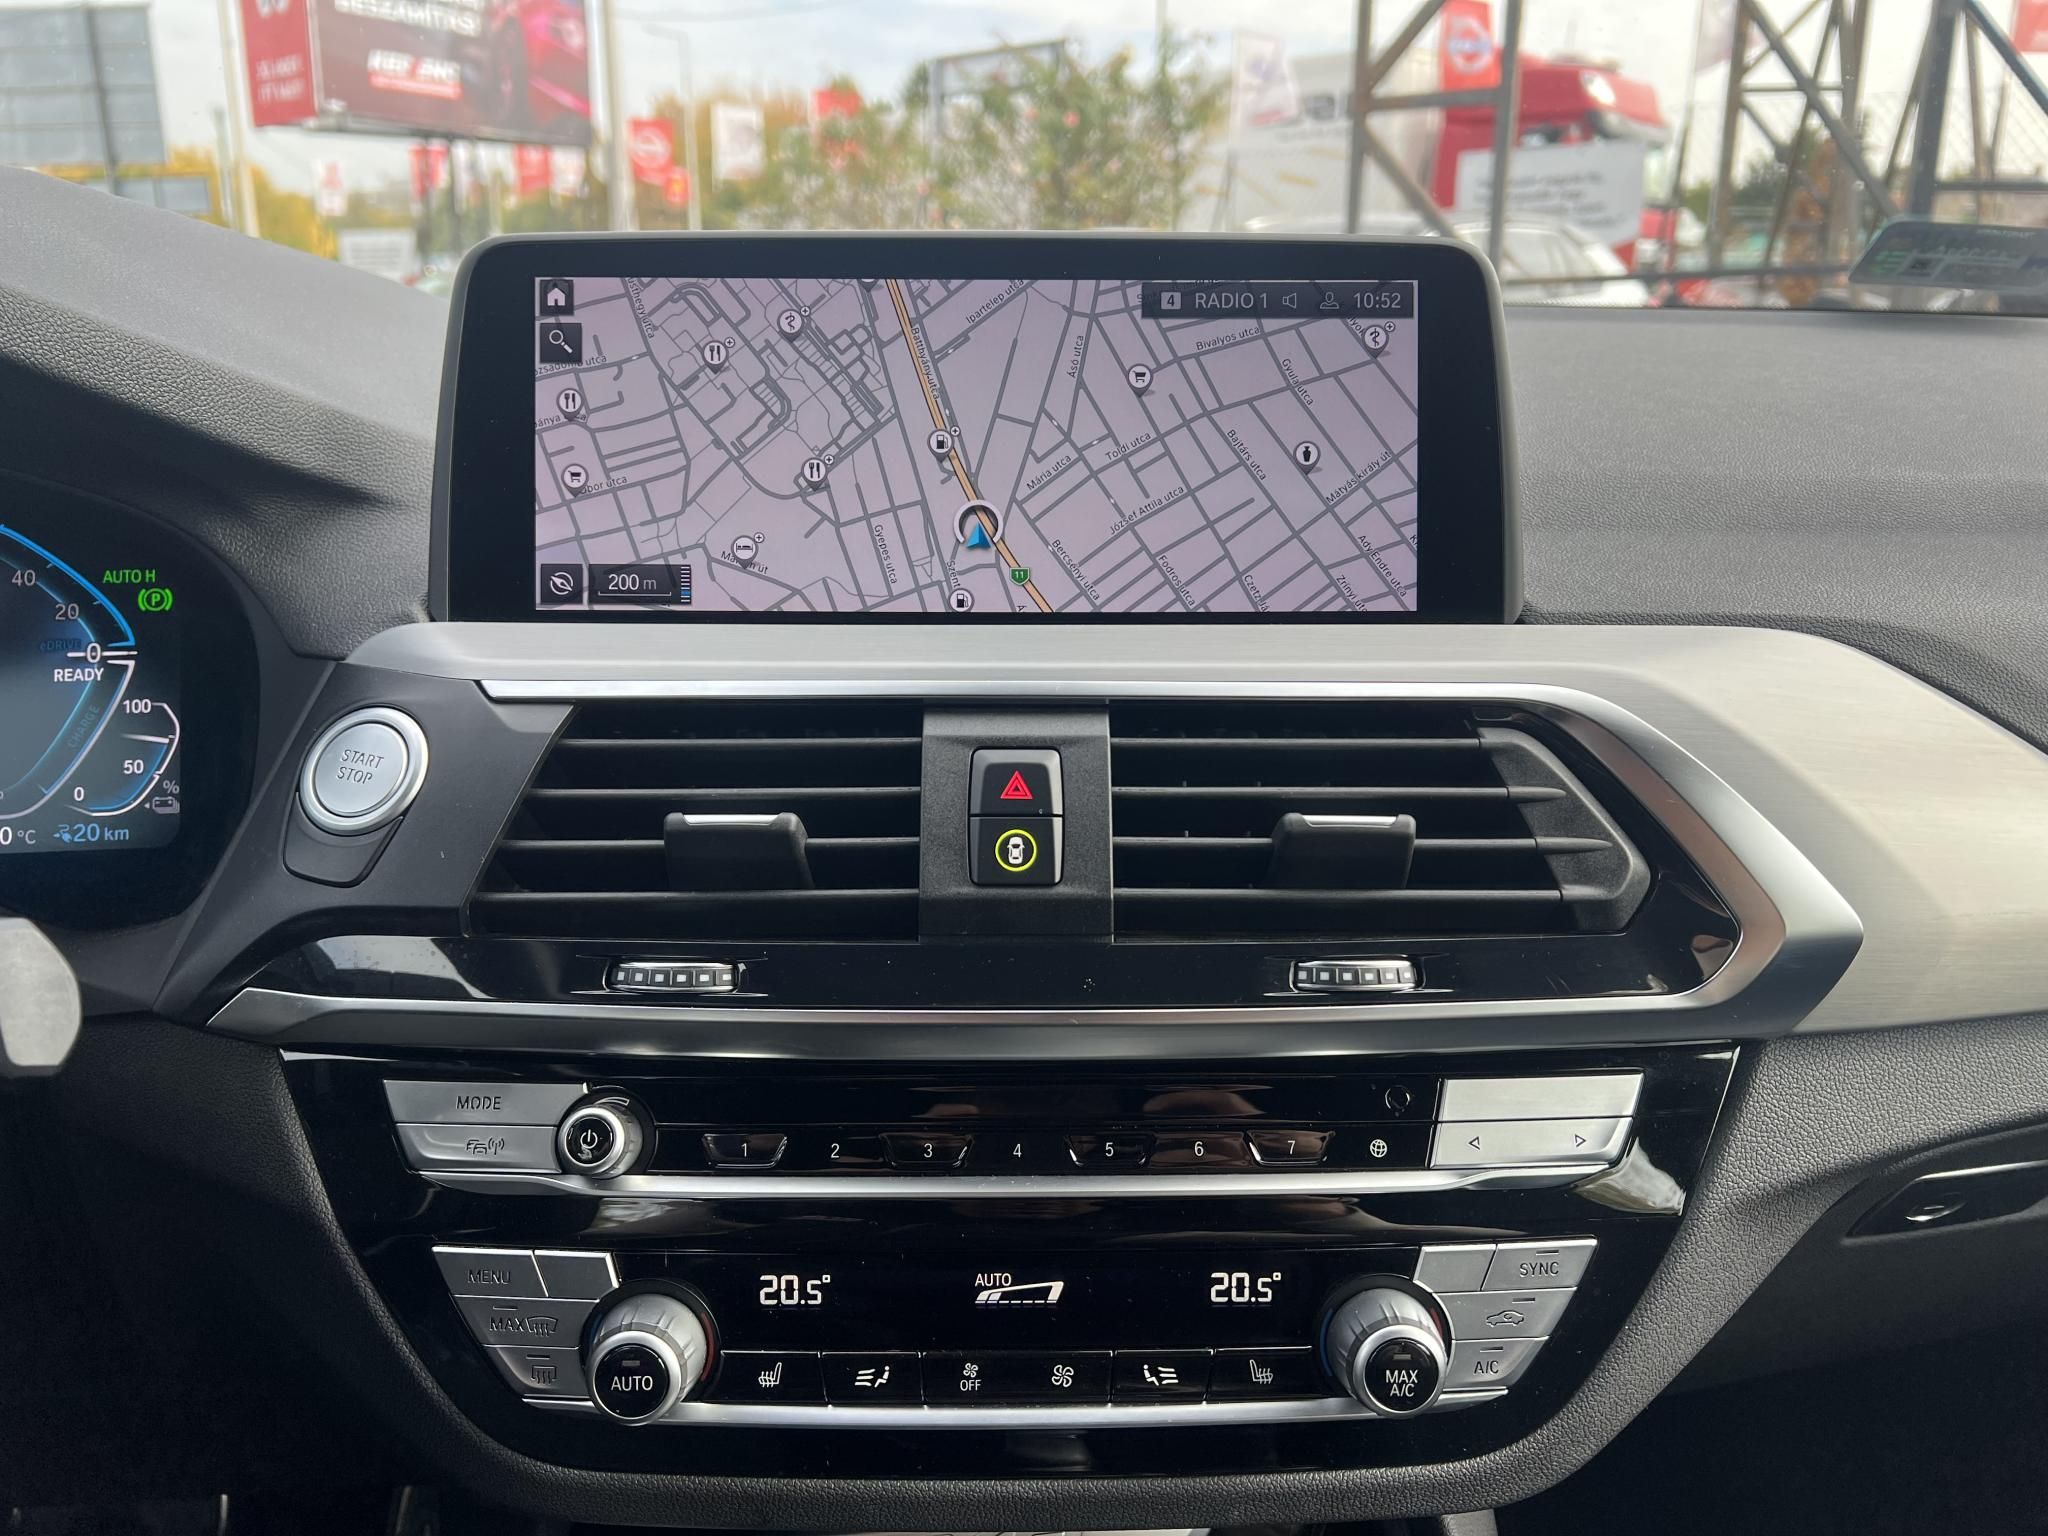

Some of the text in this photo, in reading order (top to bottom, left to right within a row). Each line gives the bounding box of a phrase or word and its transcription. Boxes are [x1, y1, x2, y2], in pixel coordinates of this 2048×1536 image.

[966, 279, 1024, 324] Ipartelep utca
[1166, 294, 1175, 306] 4
[1195, 292, 1254, 308] RADIO
[1260, 292, 1268, 308] 1
[1354, 292, 1402, 308] 10:52
[642, 317, 655, 338] utca
[1196, 326, 1260, 352] Bivalyos utca
[586, 355, 608, 368] utca
[911, 327, 940, 400] Batthyány utca
[1067, 335, 1084, 378] Ásó utca
[1281, 358, 1314, 406] Gyula utca
[1105, 432, 1152, 461] Toldi utca
[1026, 455, 1072, 491] Mária utca
[1248, 460, 1266, 480] utca
[1326, 450, 1391, 504] Mátyás király út
[606, 476, 628, 488] utca
[1110, 486, 1184, 536] József Attila utca
[874, 524, 898, 584] Gyepes utca
[946, 560, 960, 588] Szent
[1016, 570, 1024, 580] 11
[1052, 538, 1100, 602] Bercsényi utca
[1358, 535, 1408, 598] Ady Endre utca
[12, 570, 36, 586] 40
[103, 570, 156, 584] AUTO H
[608, 574, 657, 591] 200 m
[1158, 555, 1196, 606] Fodros utca
[56, 603, 80, 620] 20
[86, 642, 102, 663] 0
[54, 668, 104, 682] READY
[123, 699, 152, 714] 100
[123, 759, 144, 775] 50
[341, 749, 384, 769] START
[336, 766, 373, 785] STOP
[74, 786, 85, 802] 0
[17, 830, 36, 844] °C
[73, 823, 130, 842] 20 km
[456, 1096, 502, 1111] MODE
[741, 1140, 1296, 1158] 1 2 3 4 5 6 7
[467, 1269, 511, 1285] MENU
[1519, 1261, 1560, 1278] SYNC
[974, 1273, 1012, 1287] AUTO
[489, 1316, 525, 1332] MAX
[1474, 1360, 1500, 1375] A/C
[610, 1374, 654, 1392] AUTO
[1385, 1369, 1418, 1384] MAX
[960, 1380, 982, 1392] OFF
[1390, 1383, 1415, 1398] A/C
